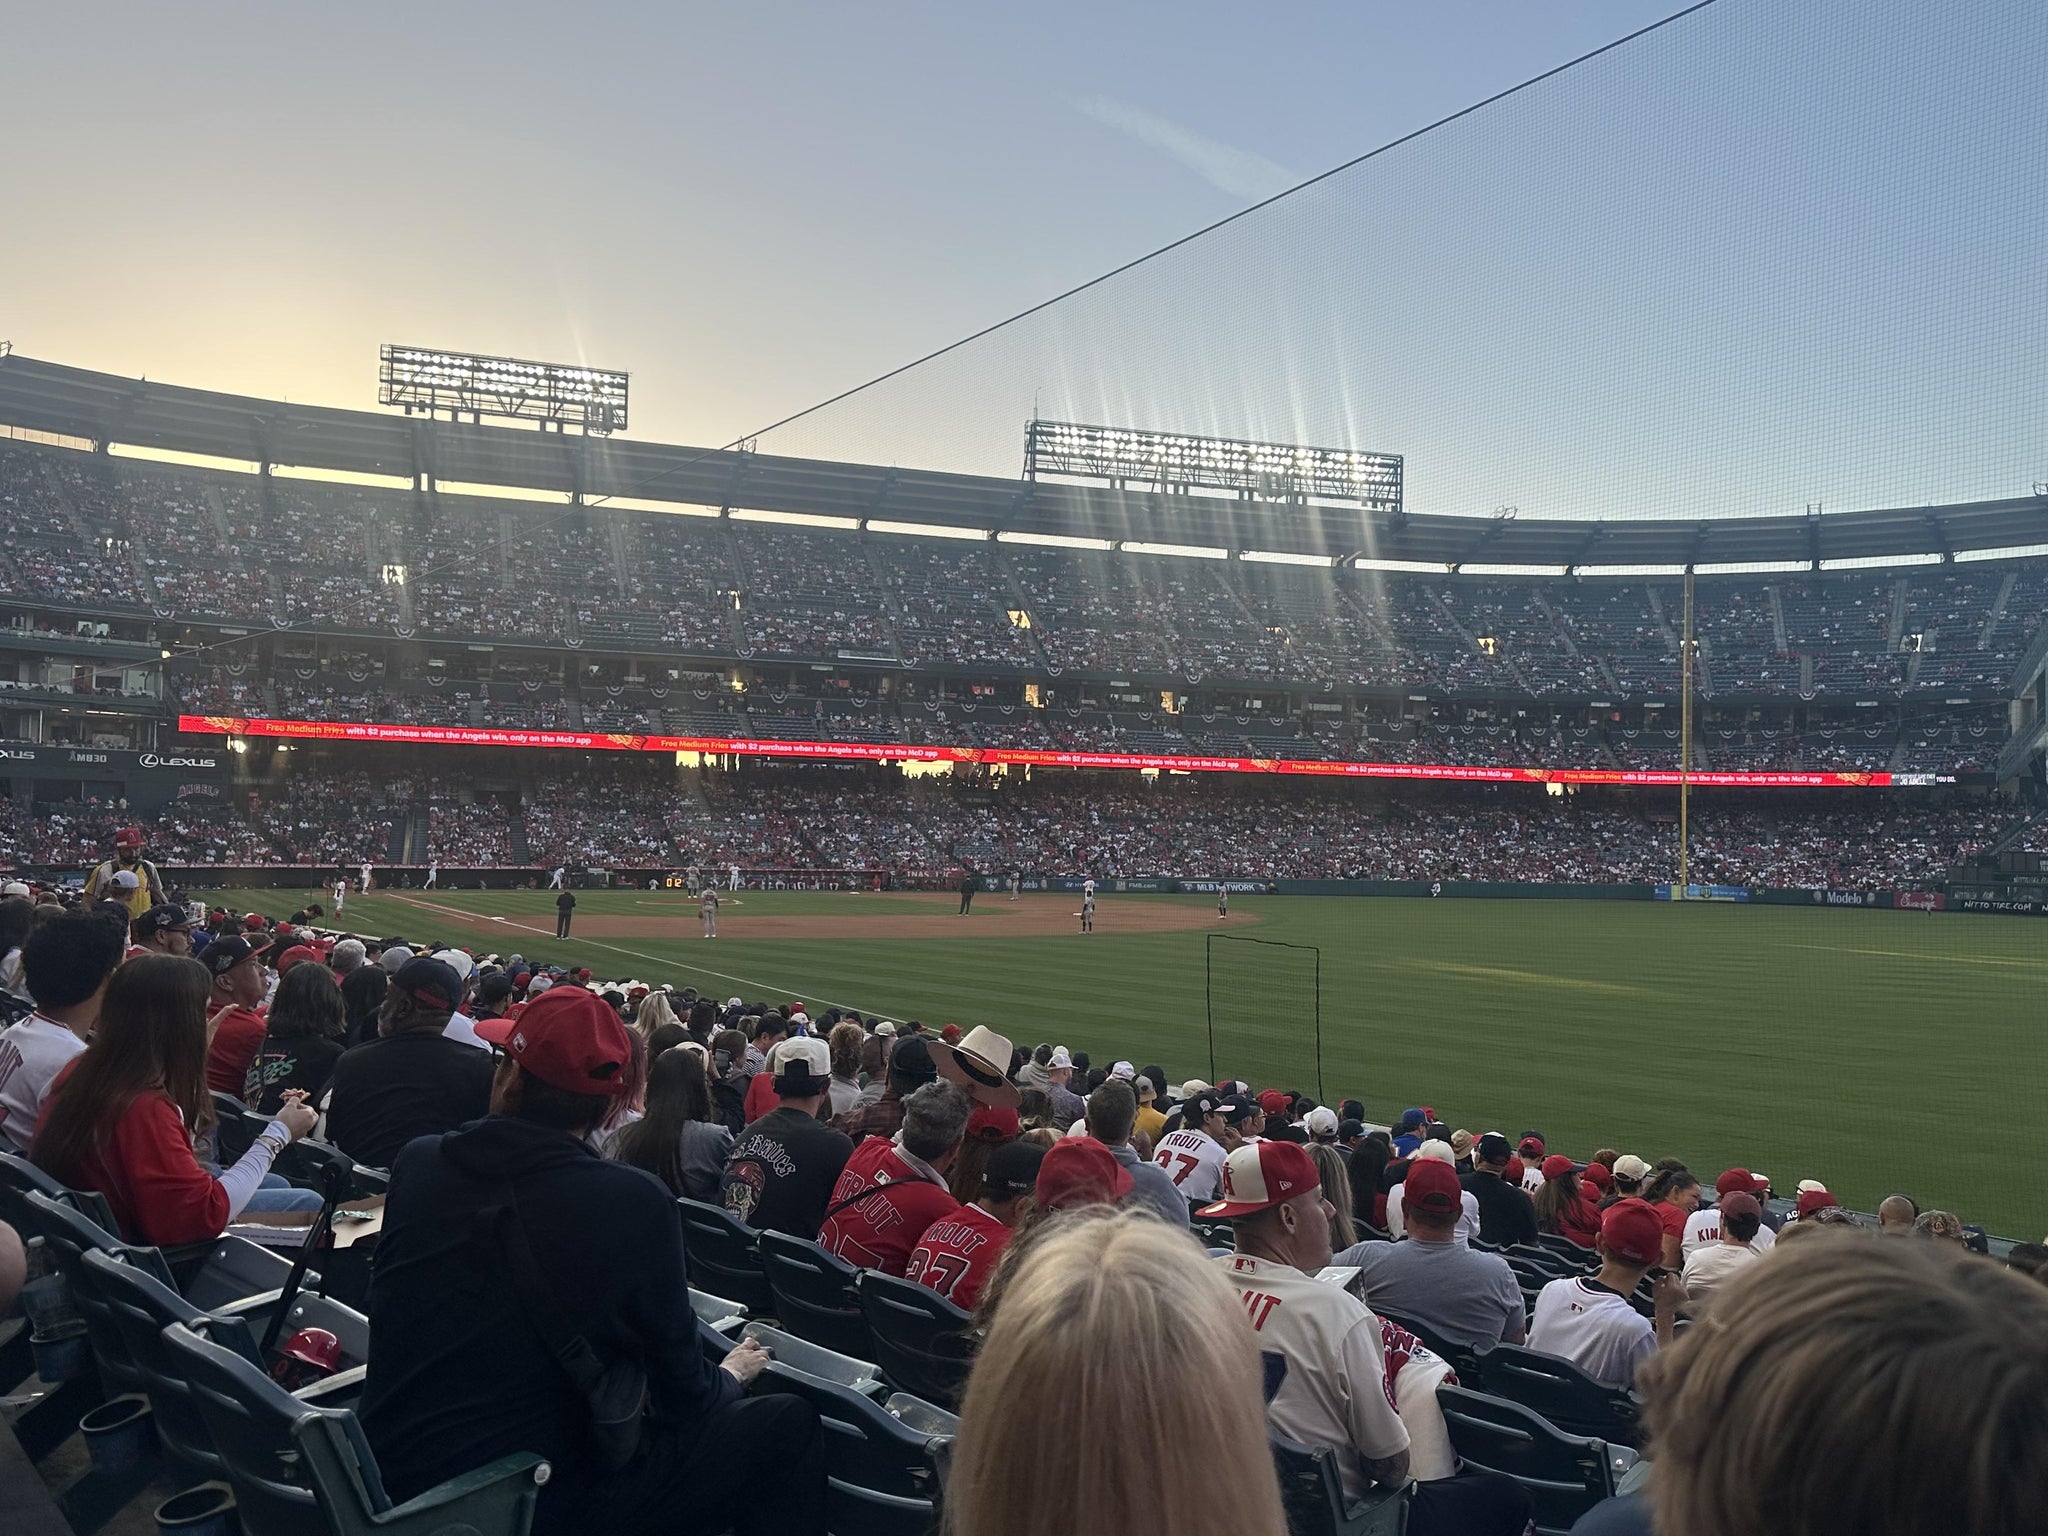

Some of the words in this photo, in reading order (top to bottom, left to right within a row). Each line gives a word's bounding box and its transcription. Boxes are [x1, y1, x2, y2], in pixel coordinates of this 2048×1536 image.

[160, 757, 216, 767] LEXUS
[1826, 892, 1862, 904] Modelo
[1964, 901, 1989, 909] NITTO
[1166, 1133, 1206, 1152] TROUT
[836, 1169, 904, 1236] TROUT
